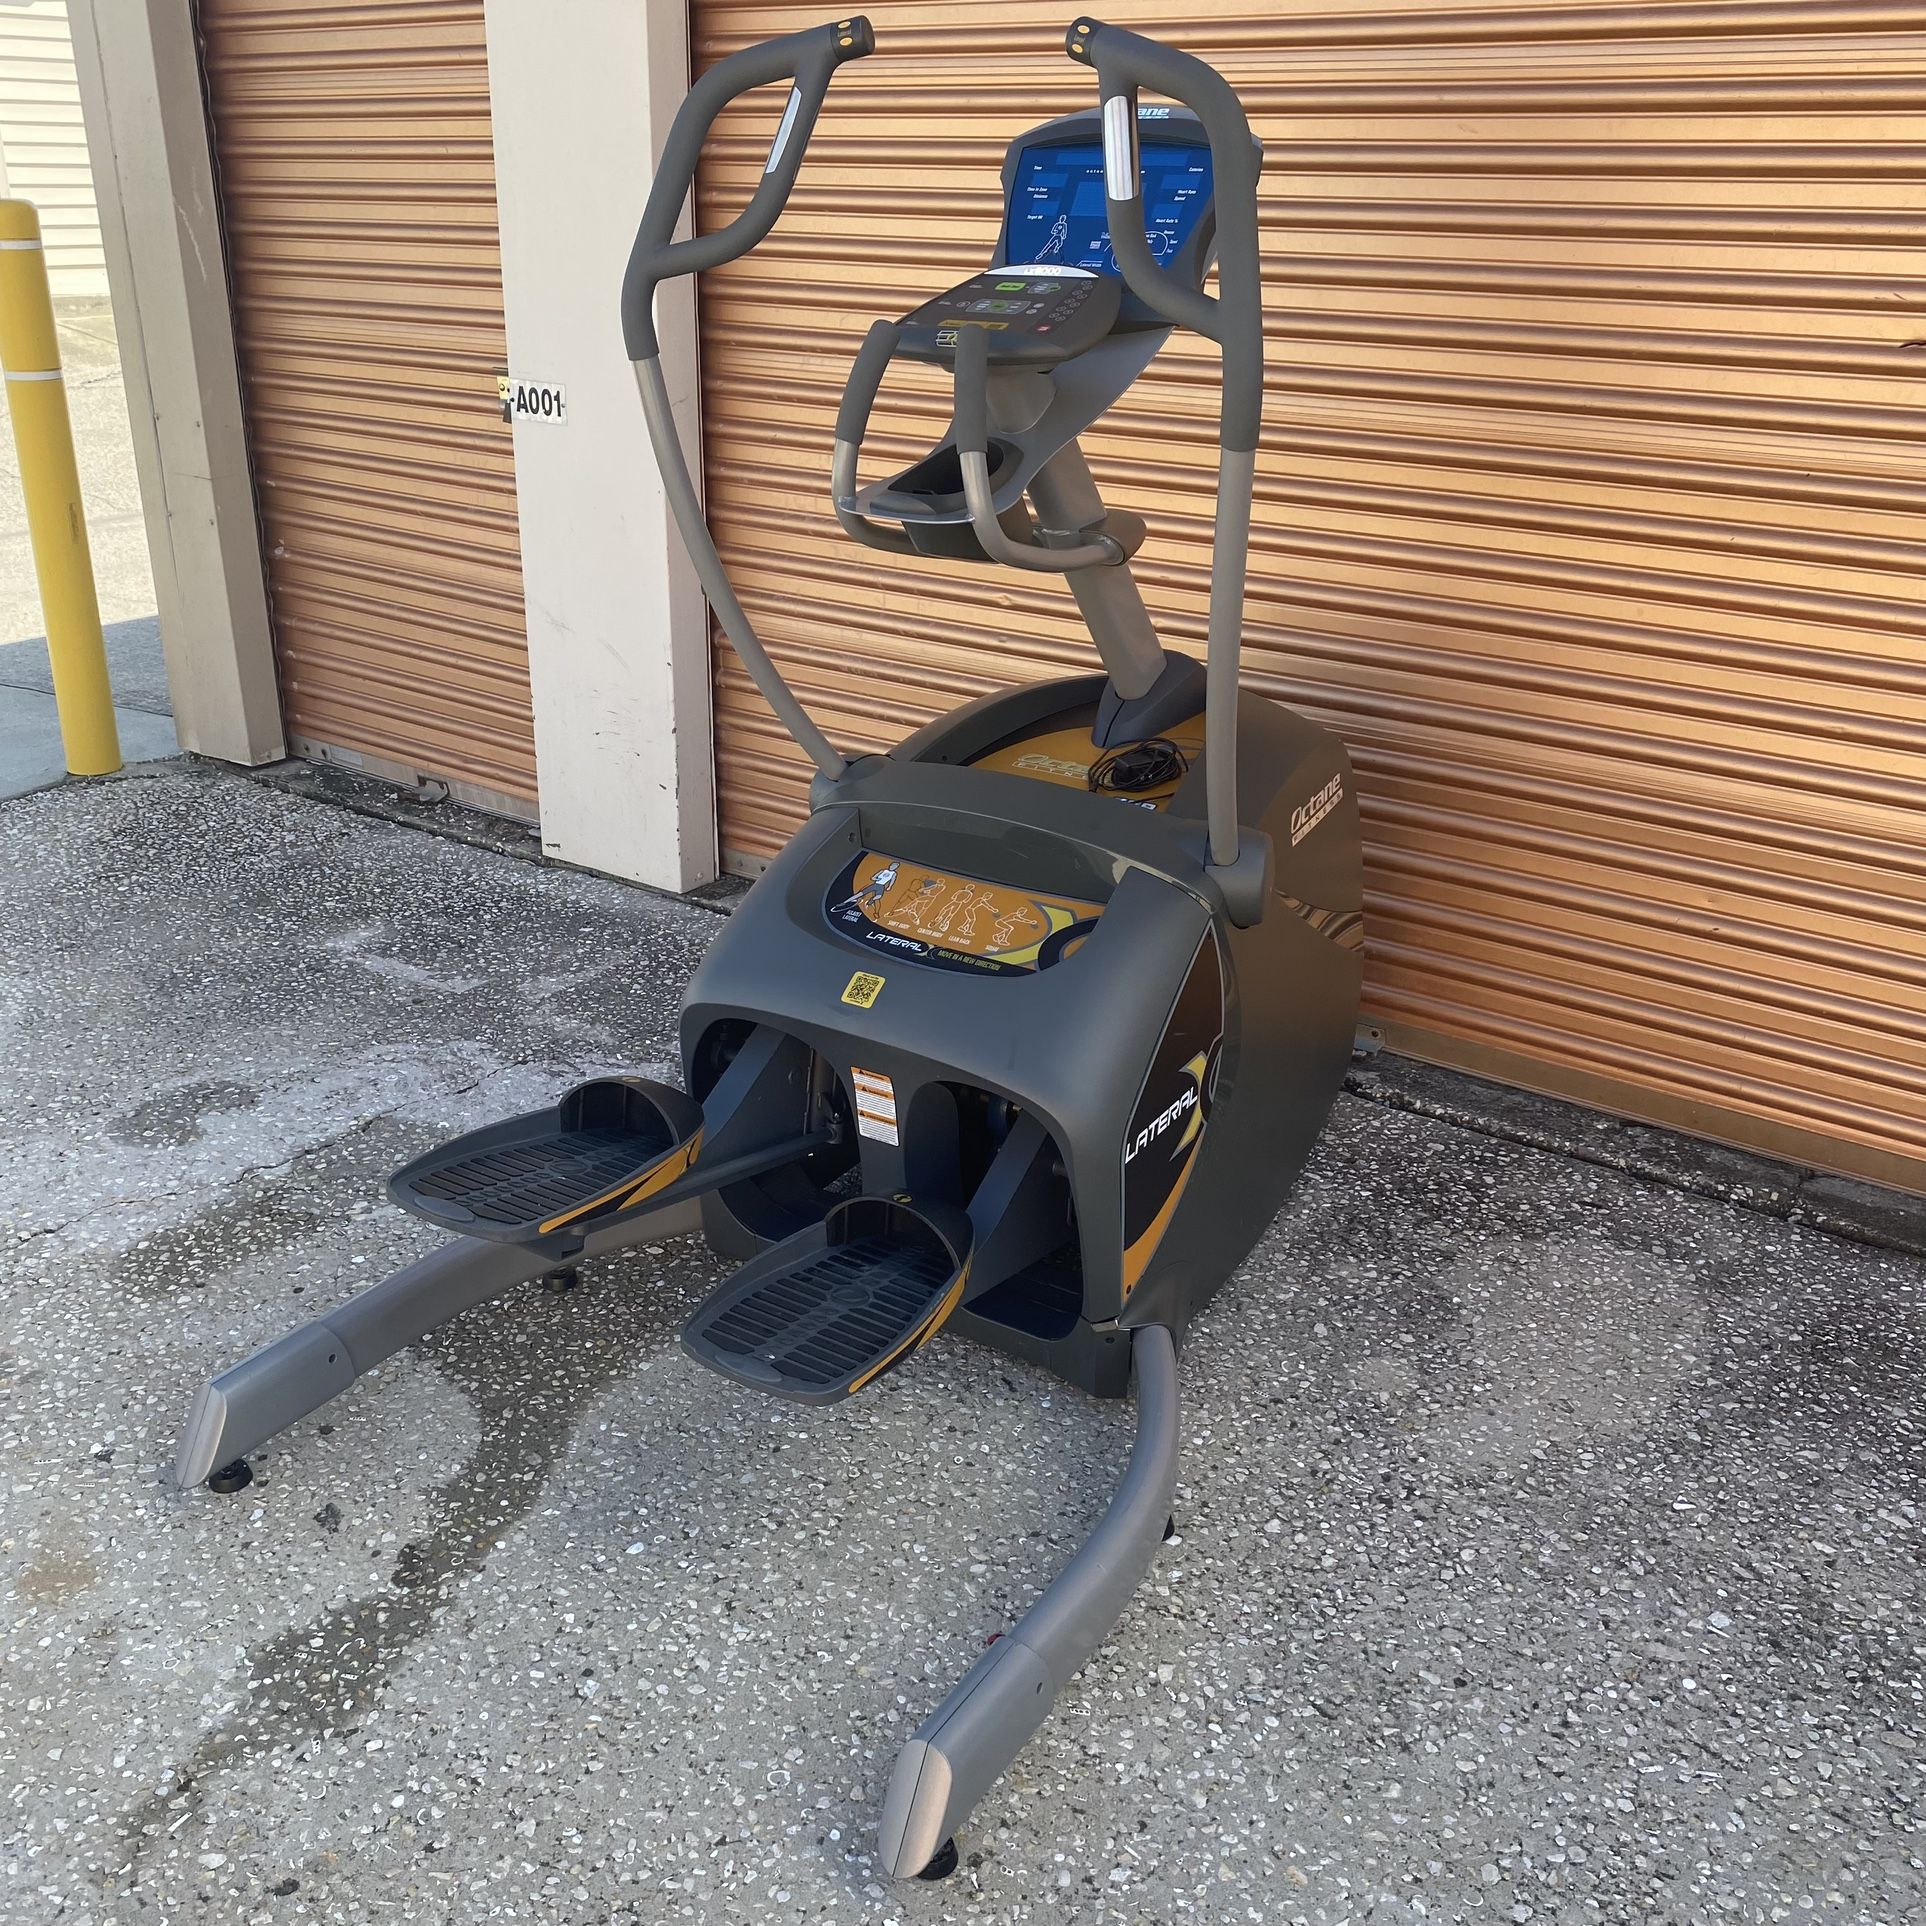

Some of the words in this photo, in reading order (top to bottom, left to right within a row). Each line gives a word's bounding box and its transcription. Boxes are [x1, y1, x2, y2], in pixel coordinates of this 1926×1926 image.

[1137, 107, 1170, 116] ane
[516, 385, 562, 418] A001
[1290, 772, 1341, 834] Octane
[1292, 788, 1343, 846] FITNESS
[887, 920, 900, 928] SHIFT
[866, 931, 923, 952] LATERAL
[948, 935, 960, 943] LEAN
[959, 937, 971, 945] BACK
[937, 949, 952, 959] MOVE
[962, 955, 975, 965] NEW
[974, 959, 1002, 972] DIRECTION
[1124, 1086, 1198, 1165] LATERAL
